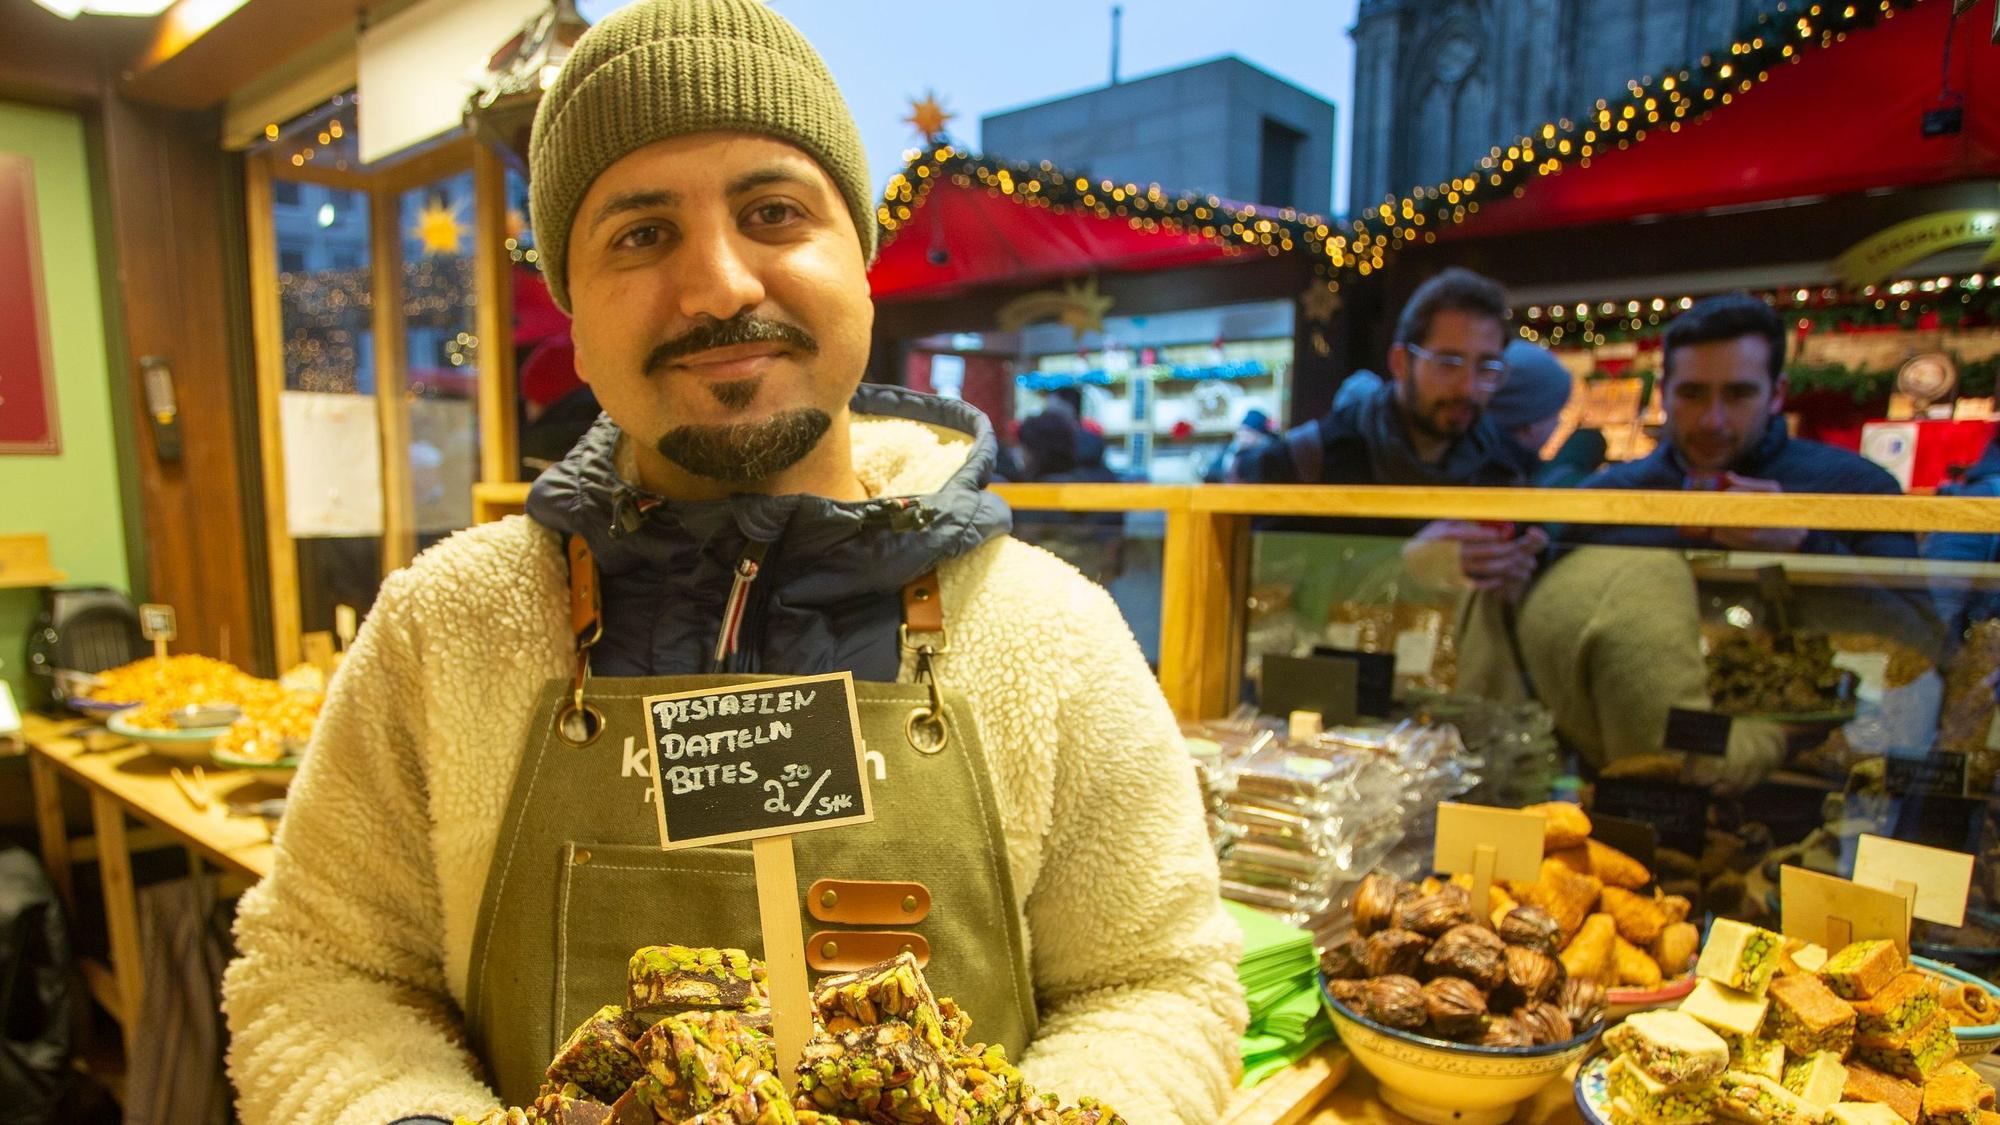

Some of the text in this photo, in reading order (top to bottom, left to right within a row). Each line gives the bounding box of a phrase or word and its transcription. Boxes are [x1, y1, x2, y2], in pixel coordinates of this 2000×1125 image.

[653, 690, 816, 730] PISTAZIEN
[660, 721, 792, 760] DATTELN
[665, 761, 759, 795] BITES
